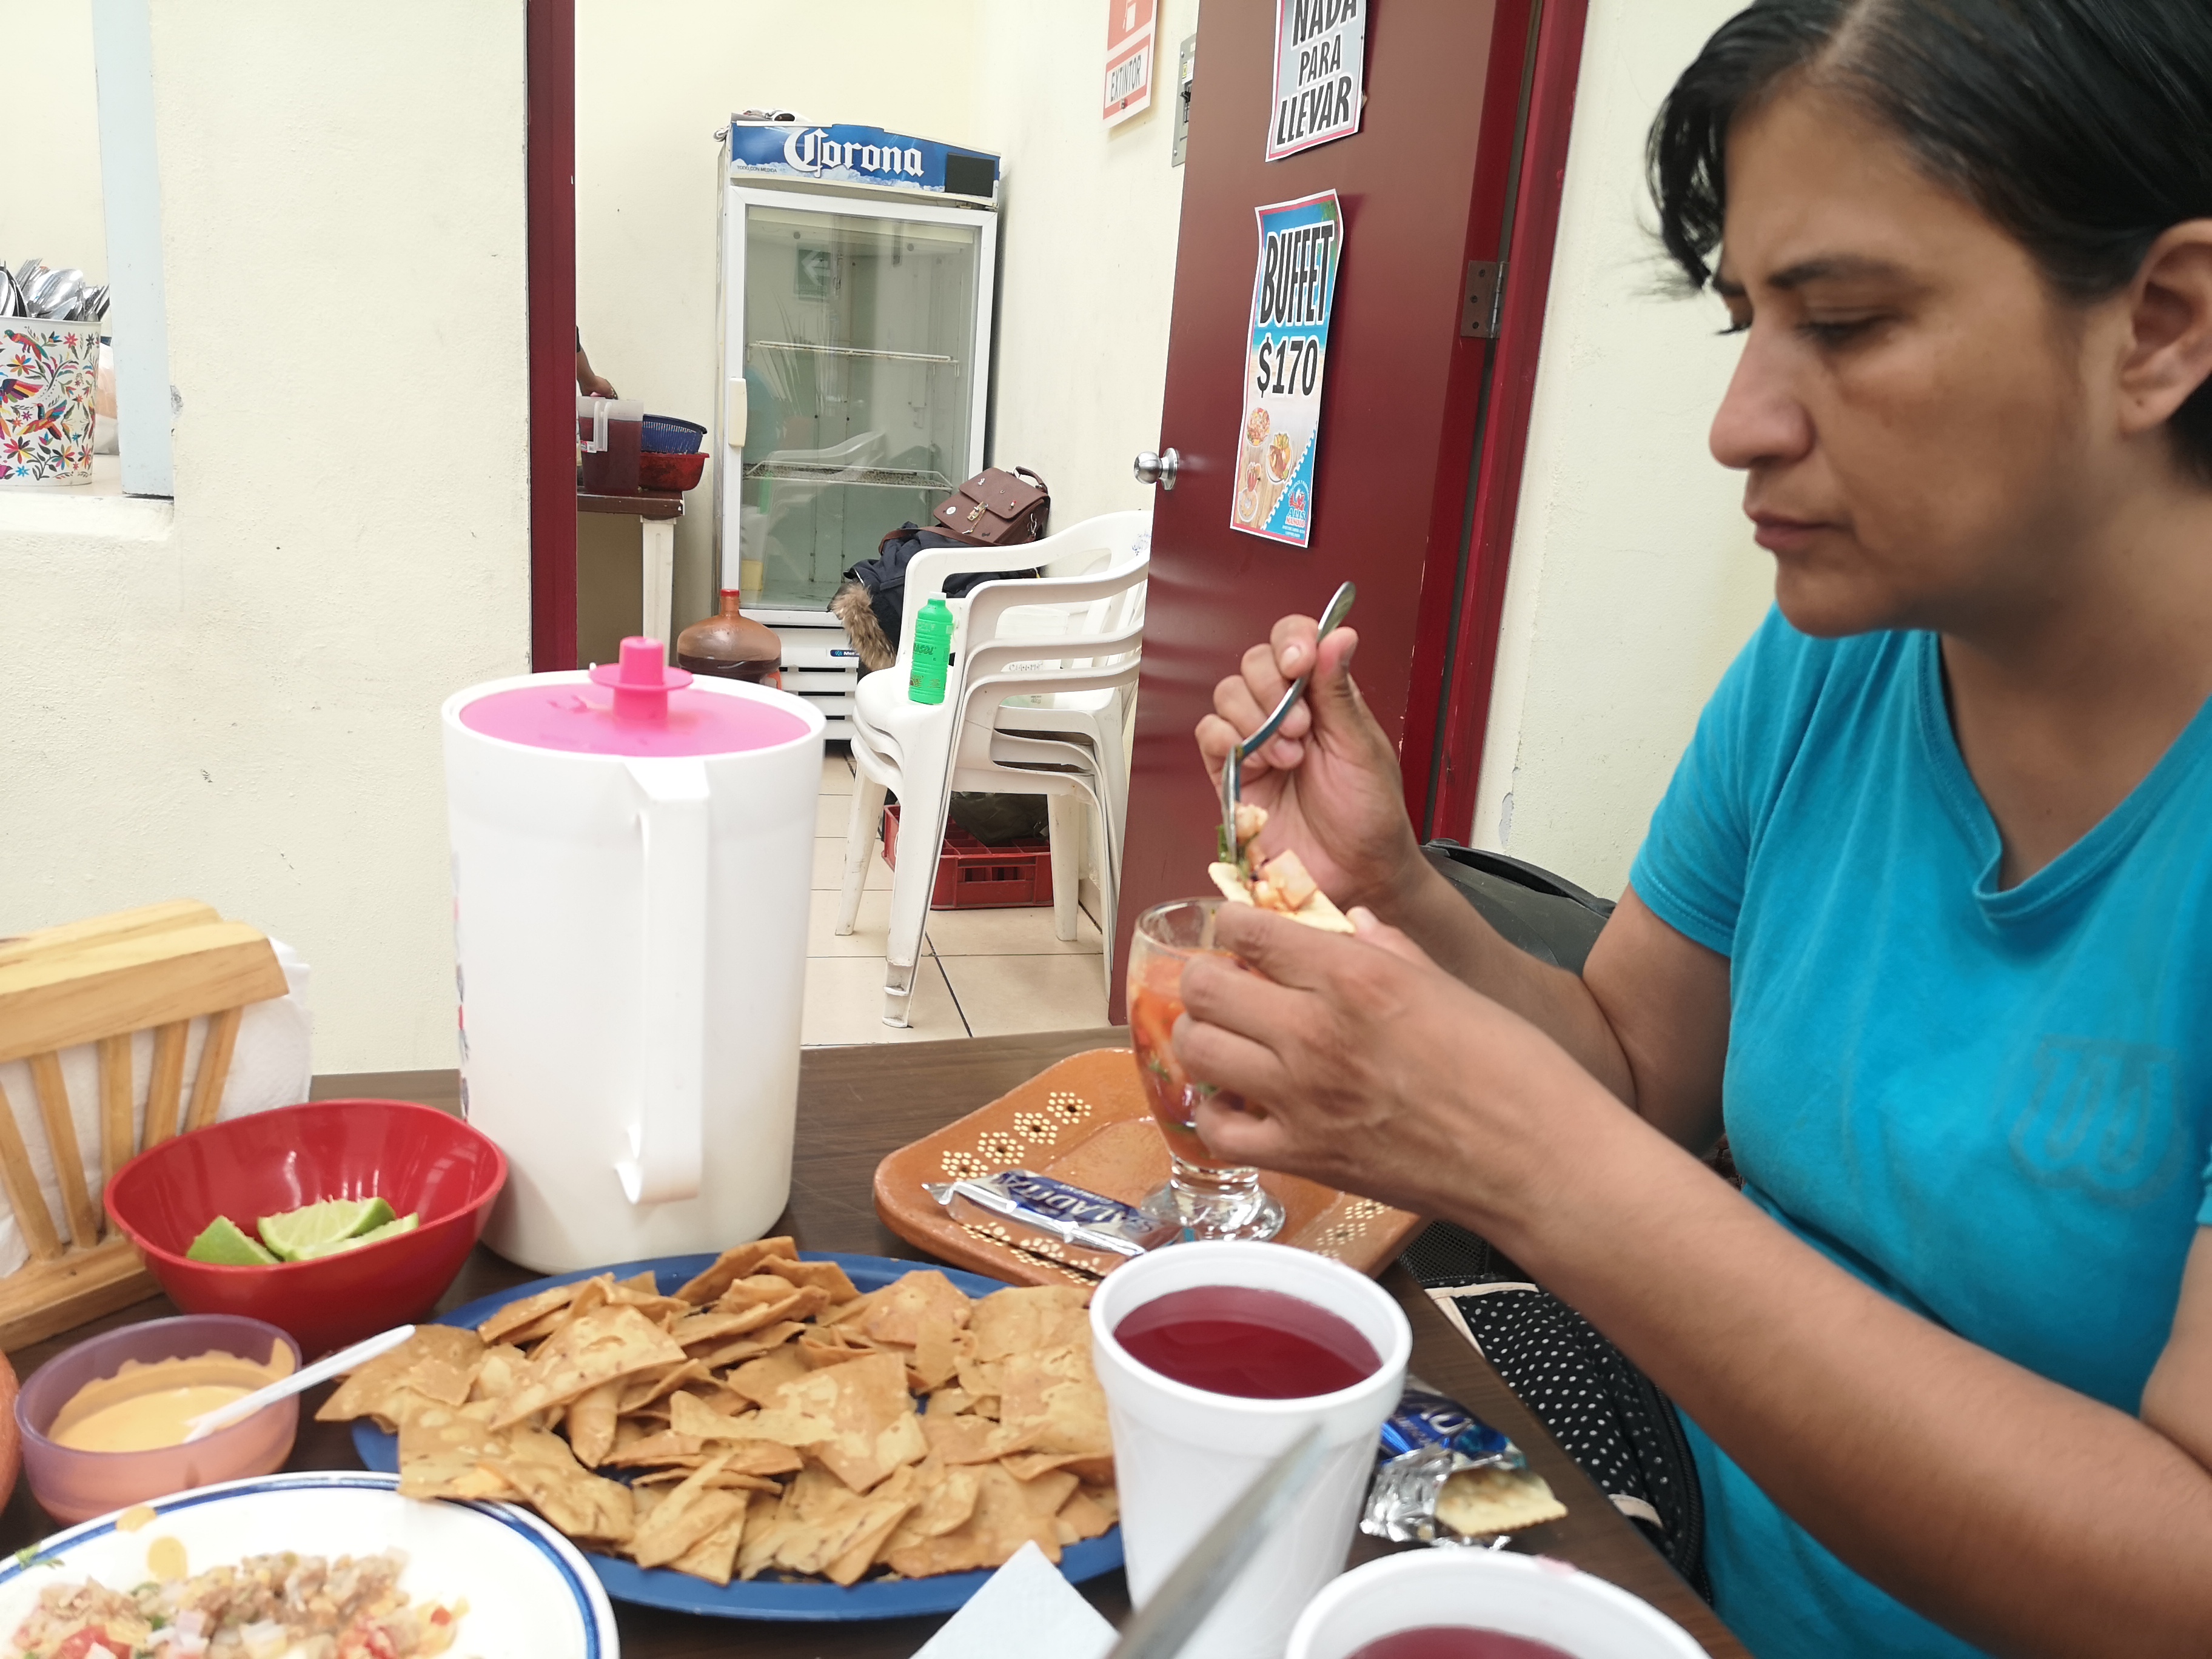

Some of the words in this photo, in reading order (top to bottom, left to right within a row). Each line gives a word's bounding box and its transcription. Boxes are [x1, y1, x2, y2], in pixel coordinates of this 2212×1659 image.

[1111, 55, 1141, 101] EXTINTOR
[1298, 35, 1341, 87] PARA
[1276, 76, 1352, 146] LLEVAR
[784, 128, 923, 178] Corona
[1259, 224, 1333, 324] BUFFET
[1257, 337, 1318, 398] $170
